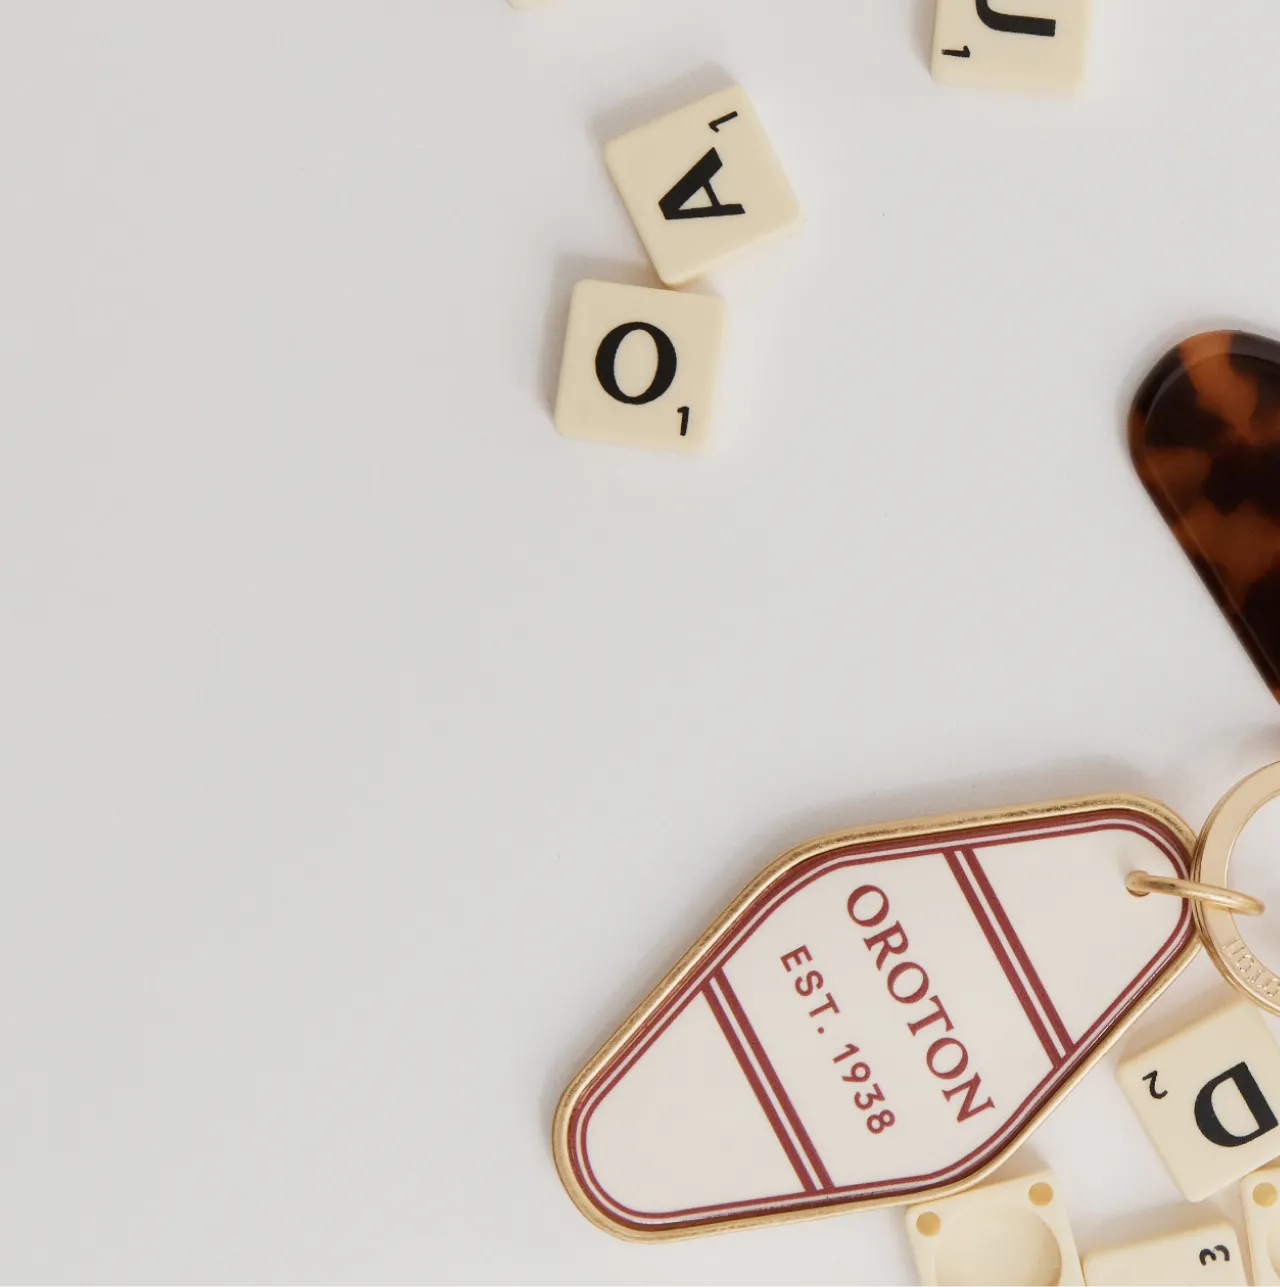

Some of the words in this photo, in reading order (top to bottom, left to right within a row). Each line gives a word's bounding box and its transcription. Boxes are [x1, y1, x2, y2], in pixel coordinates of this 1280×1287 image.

[658, 146, 746, 221] A
[708, 110, 738, 133] 1
[594, 321, 678, 406] O
[677, 405, 690, 437] 1
[780, 945, 839, 1035] EST.
[833, 1043, 895, 1135] 1938
[847, 885, 994, 1123] OROTON
[1142, 1070, 1168, 1100] 2
[1193, 1061, 1279, 1148] D
